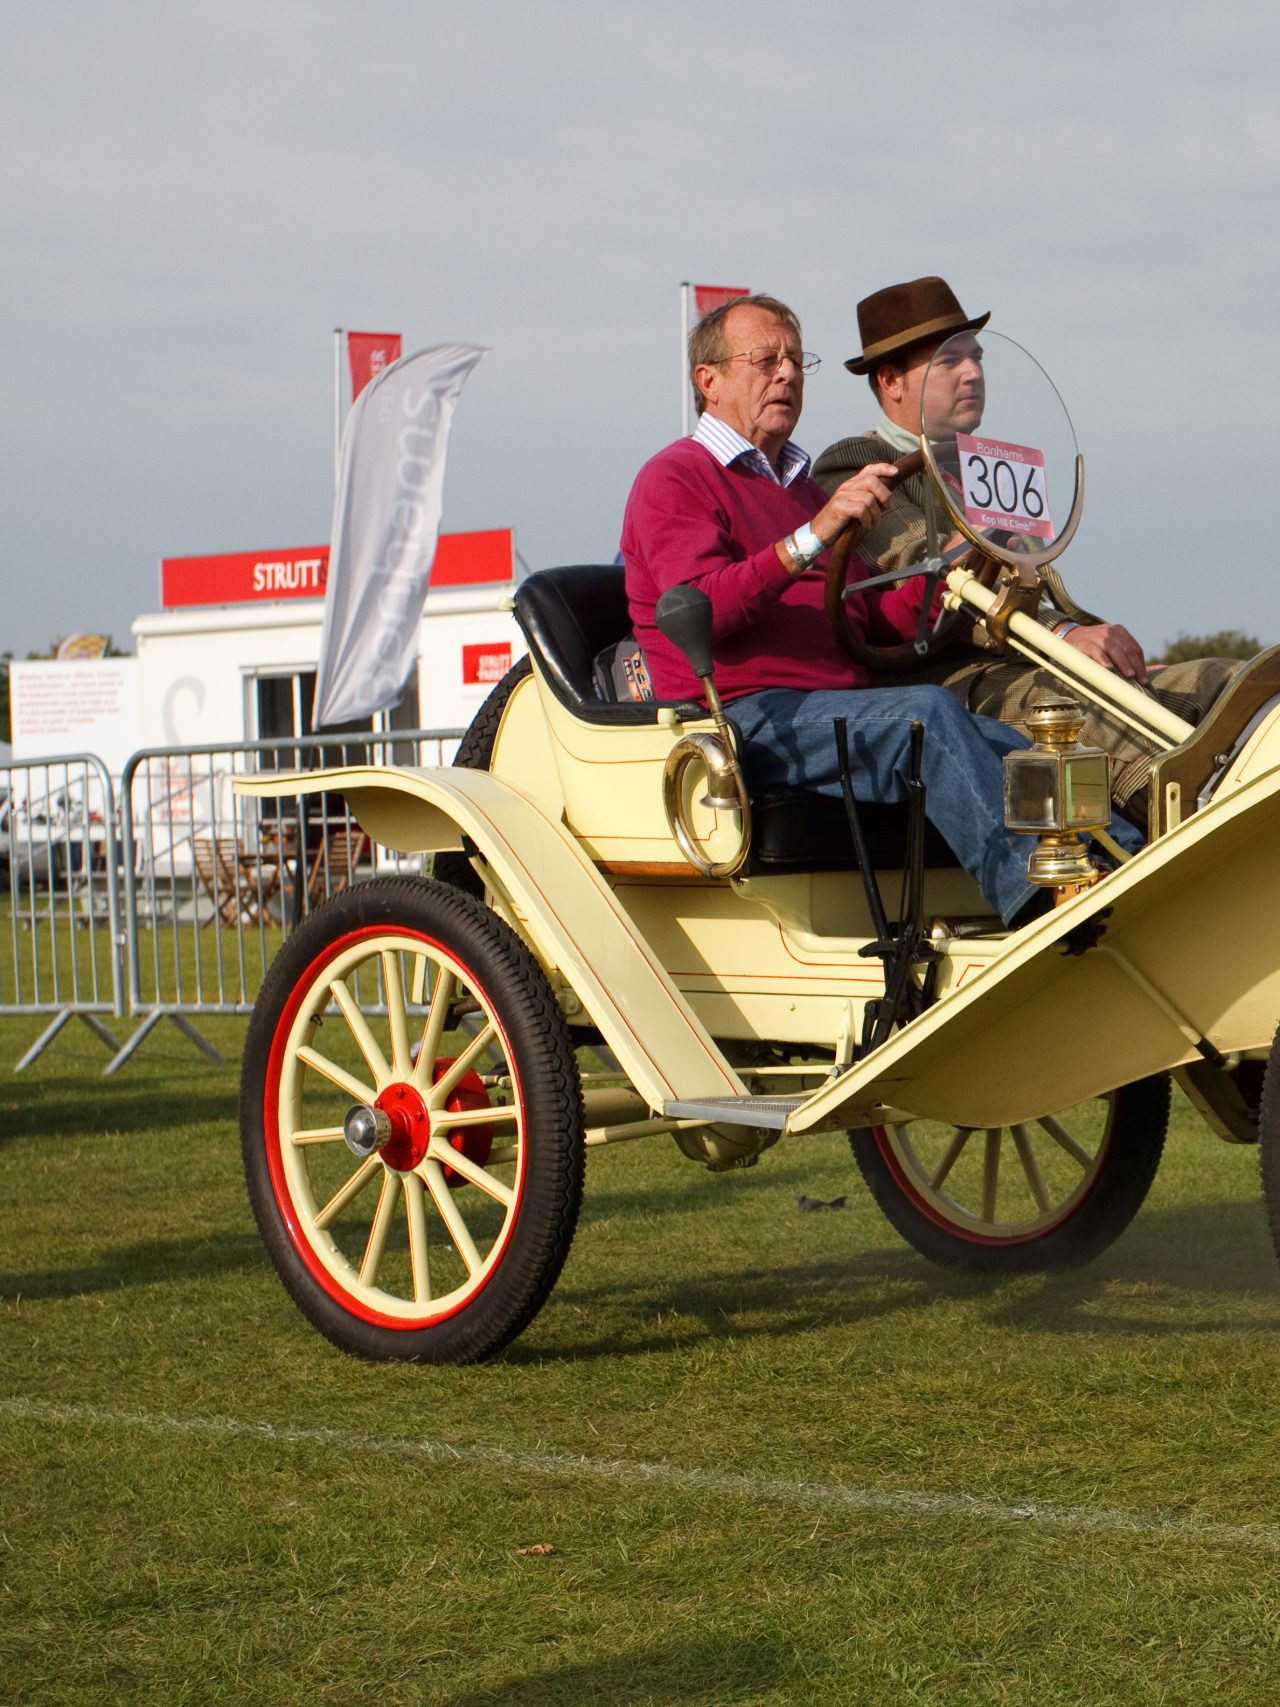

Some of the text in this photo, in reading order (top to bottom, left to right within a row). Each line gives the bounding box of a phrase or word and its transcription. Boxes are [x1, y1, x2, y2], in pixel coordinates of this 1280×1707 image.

[976, 442, 1024, 462] Bonhams
[968, 454, 1044, 518] 306
[981, 514, 997, 526] Kop
[252, 559, 321, 592] STRUTT
